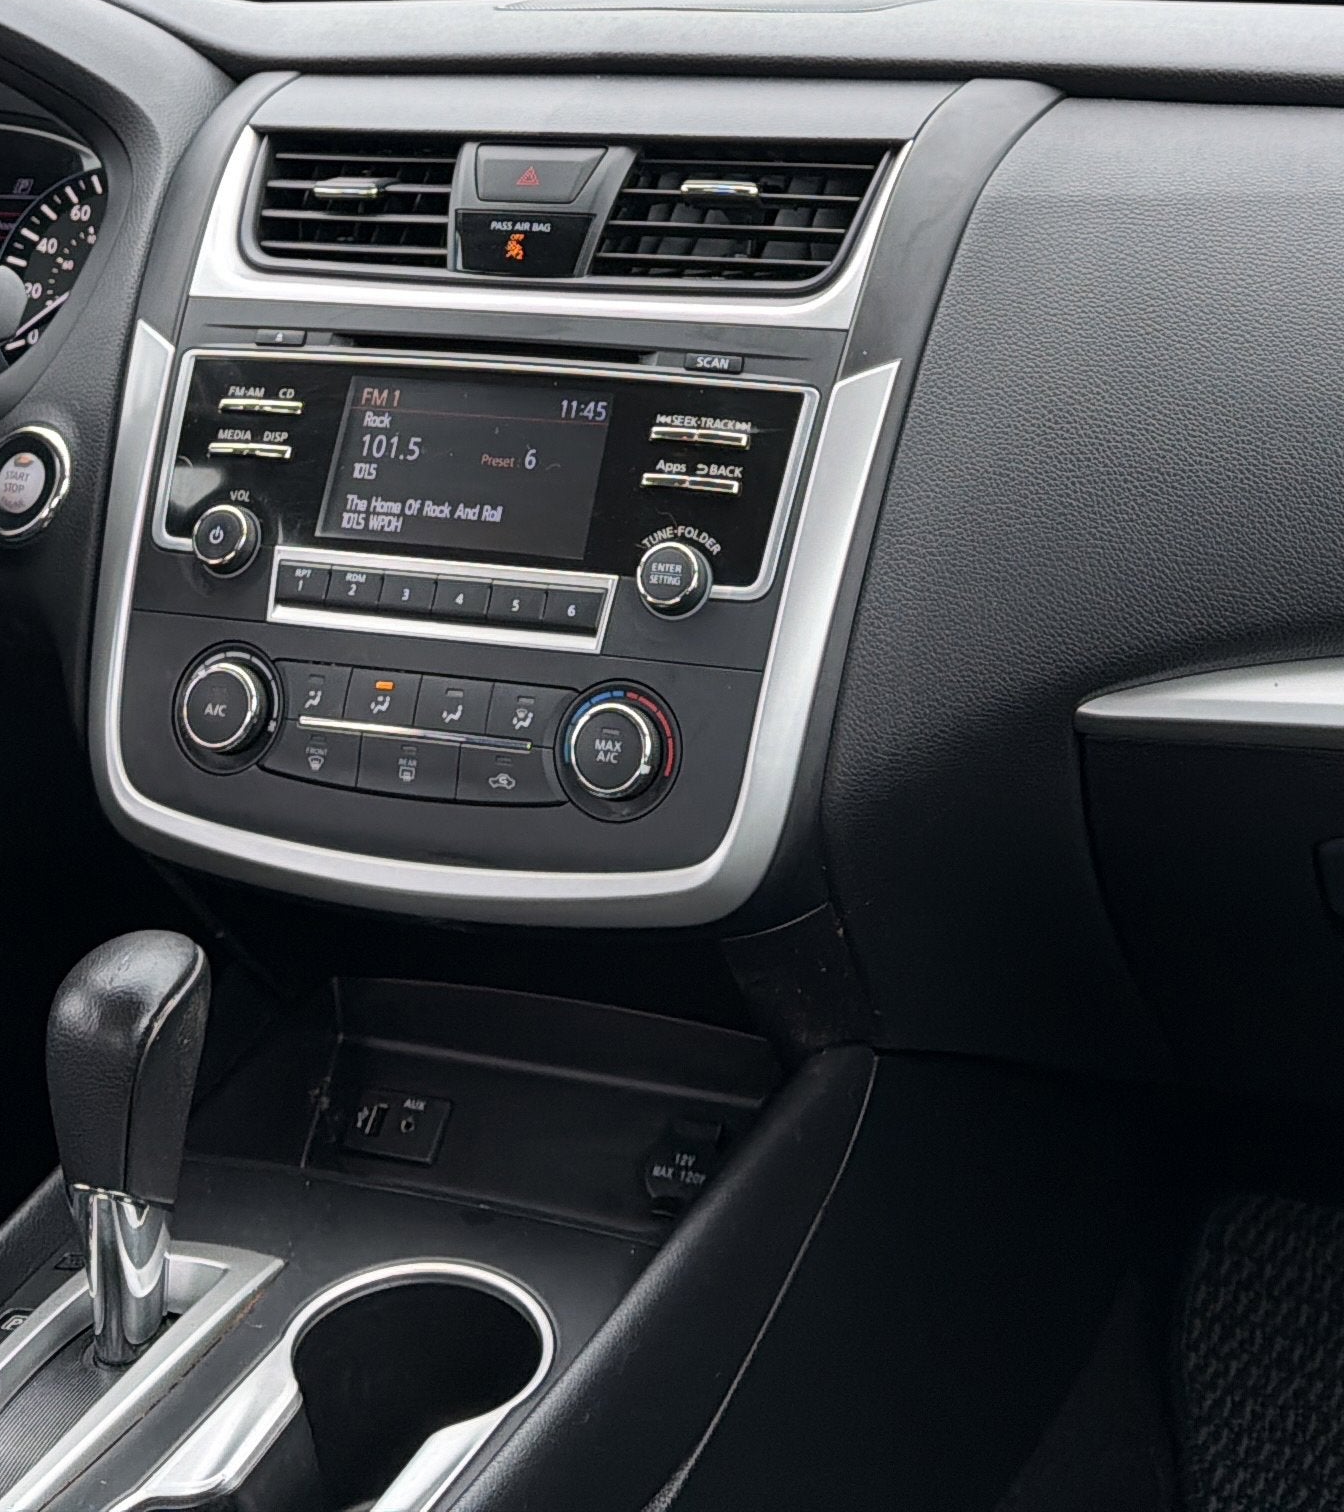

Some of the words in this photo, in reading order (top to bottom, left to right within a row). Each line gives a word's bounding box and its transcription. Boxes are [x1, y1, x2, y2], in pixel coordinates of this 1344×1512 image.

[70, 204, 92, 222] 60
[490, 220, 513, 231] PASS
[514, 221, 531, 231] AIR
[531, 222, 552, 233] BAG
[36, 237, 58, 254] 40
[27, 329, 39, 344] 0
[695, 356, 731, 370] SCAN
[278, 388, 295, 398] CD
[361, 388, 387, 407] FM
[392, 389, 402, 408] 1
[559, 399, 608, 421] 11:45
[362, 411, 392, 429] Rock
[217, 428, 252, 441] MEDIA
[262, 431, 289, 442] DISP
[360, 434, 423, 461] 101.5
[523, 448, 537, 470] 6
[655, 459, 687, 474] Apps
[709, 463, 744, 478] BACK
[4, 470, 31, 482] START
[3, 482, 26, 494] STOP
[229, 489, 251, 503] VOL
[345, 494, 367, 512] The
[370, 495, 402, 515] Home
[405, 498, 420, 516] Of
[422, 500, 451, 520] Rock
[453, 503, 481, 522] And
[482, 504, 503, 523] Roll
[368, 514, 403, 533] WPDH
[651, 562, 683, 574] ENTER
[345, 572, 367, 584] RDM
[648, 574, 682, 587] SETTING
[297, 580, 304, 592] 1
[348, 584, 357, 596] 2
[401, 588, 410, 601] 3
[455, 593, 464, 606] 4
[511, 599, 520, 612] 5
[567, 604, 576, 617] 6
[204, 702, 227, 717] A/C
[595, 738, 623, 752] MAX
[595, 750, 620, 764] A/C
[403, 1099, 426, 1112] AUX
[675, 1153, 696, 1167] 12V
[652, 1165, 675, 1179] MAX
